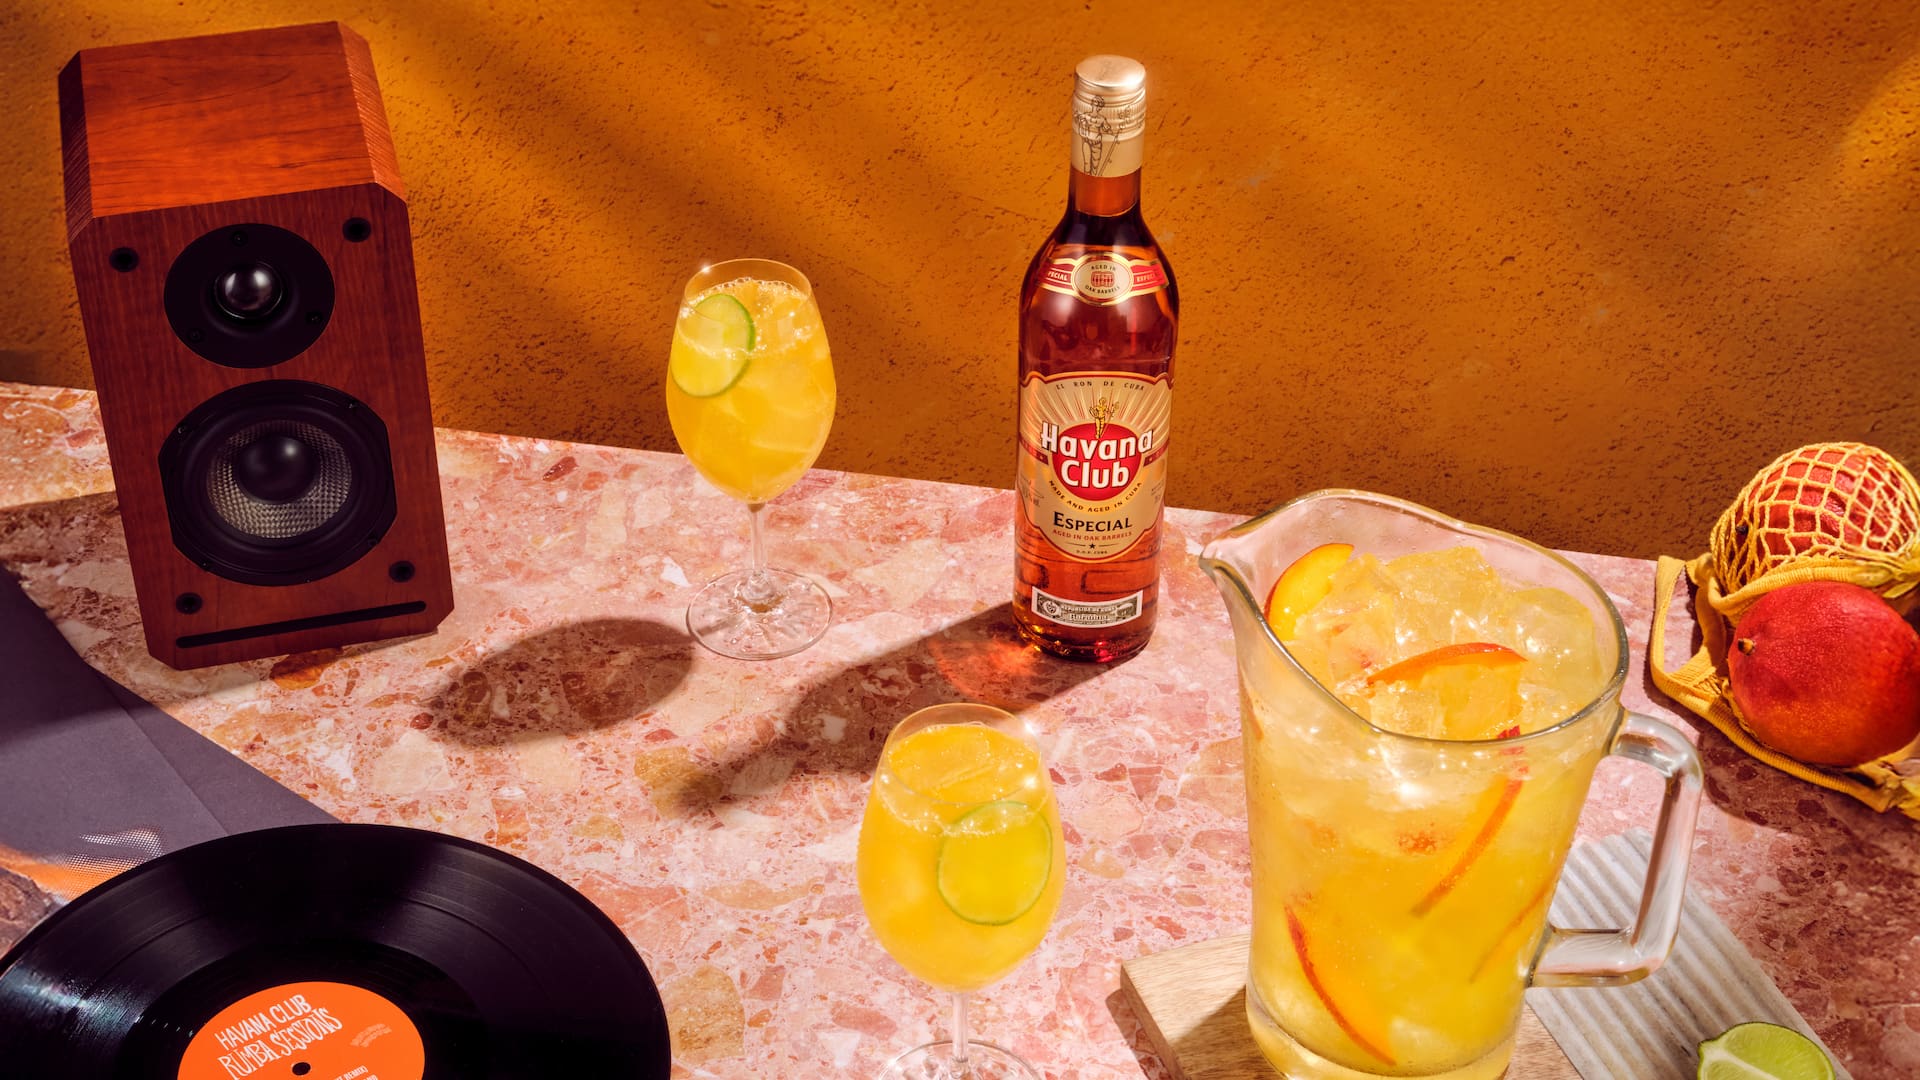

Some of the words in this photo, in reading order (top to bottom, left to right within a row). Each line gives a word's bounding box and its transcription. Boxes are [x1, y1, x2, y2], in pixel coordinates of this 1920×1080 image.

[1047, 270, 1068, 281] PECIAL
[1124, 382, 1144, 390] CUBA
[1040, 421, 1154, 461] Havana
[1060, 459, 1130, 489] Club
[1049, 480, 1066, 499] MADE
[1066, 500, 1084, 510] AND
[1125, 482, 1142, 500] CUBA
[1053, 511, 1133, 532] ESPECIAL
[1053, 529, 1071, 537] AGED
[1102, 531, 1132, 540] BARRELS
[214, 1012, 277, 1051] HAVANA
[269, 994, 312, 1024] CLUB
[217, 1039, 282, 1080] RUMBA
[269, 1007, 343, 1056] SESSIONS
